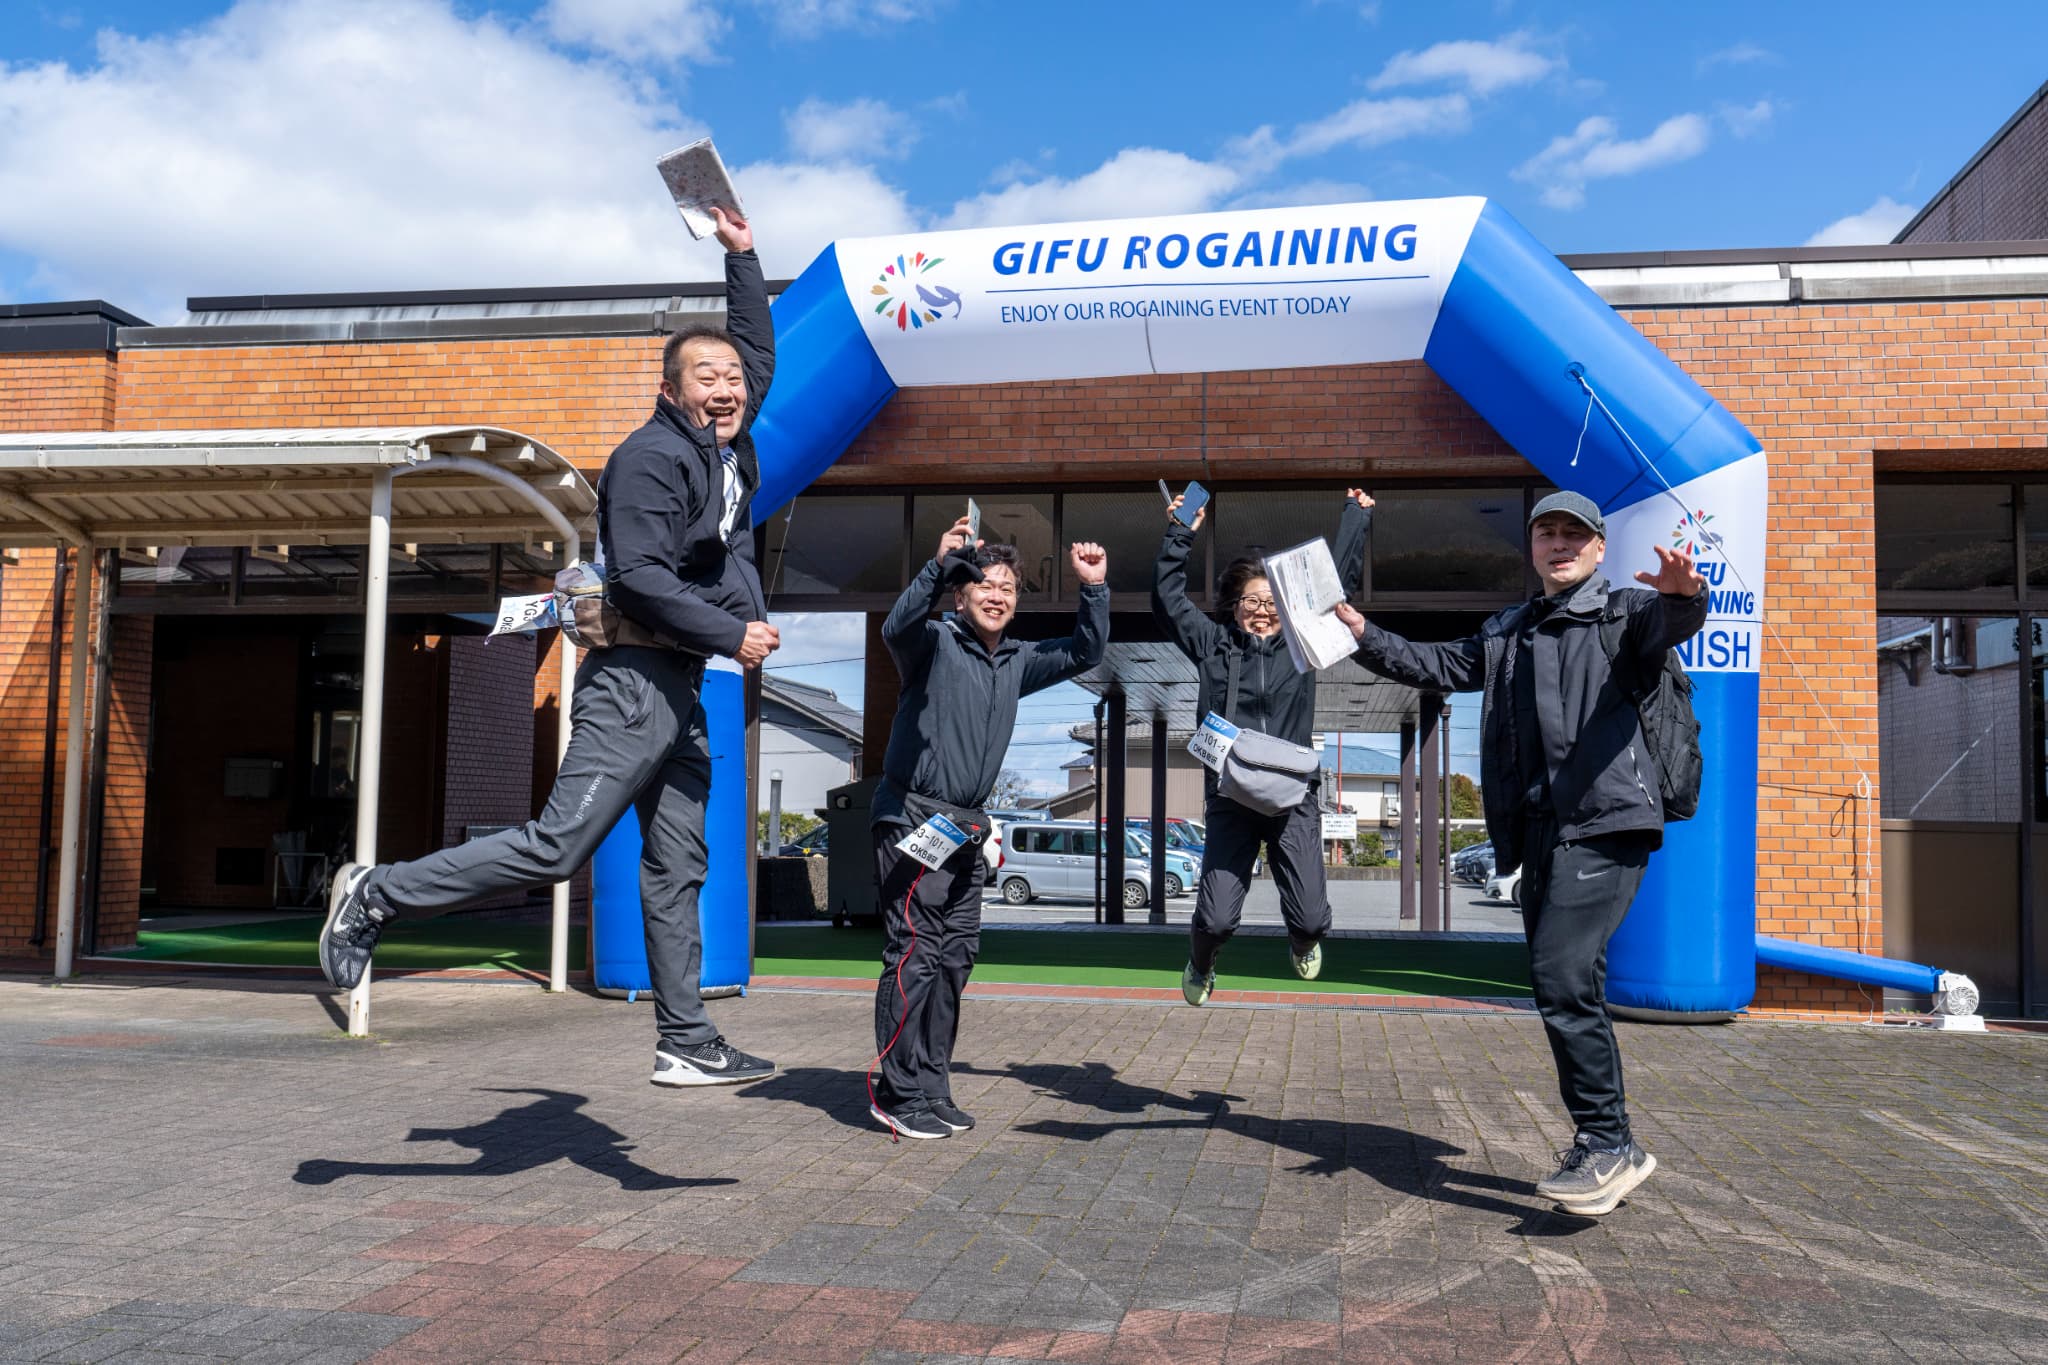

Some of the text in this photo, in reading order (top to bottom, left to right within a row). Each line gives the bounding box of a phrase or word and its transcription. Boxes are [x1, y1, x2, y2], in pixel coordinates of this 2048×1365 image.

[992, 223, 1418, 276] GIFU ROGAINING
[1001, 296, 1351, 323] ENJOY OUR ROGAINING EVENT TODAY
[1692, 562, 1726, 586] FU
[1674, 630, 1751, 668] NISH
